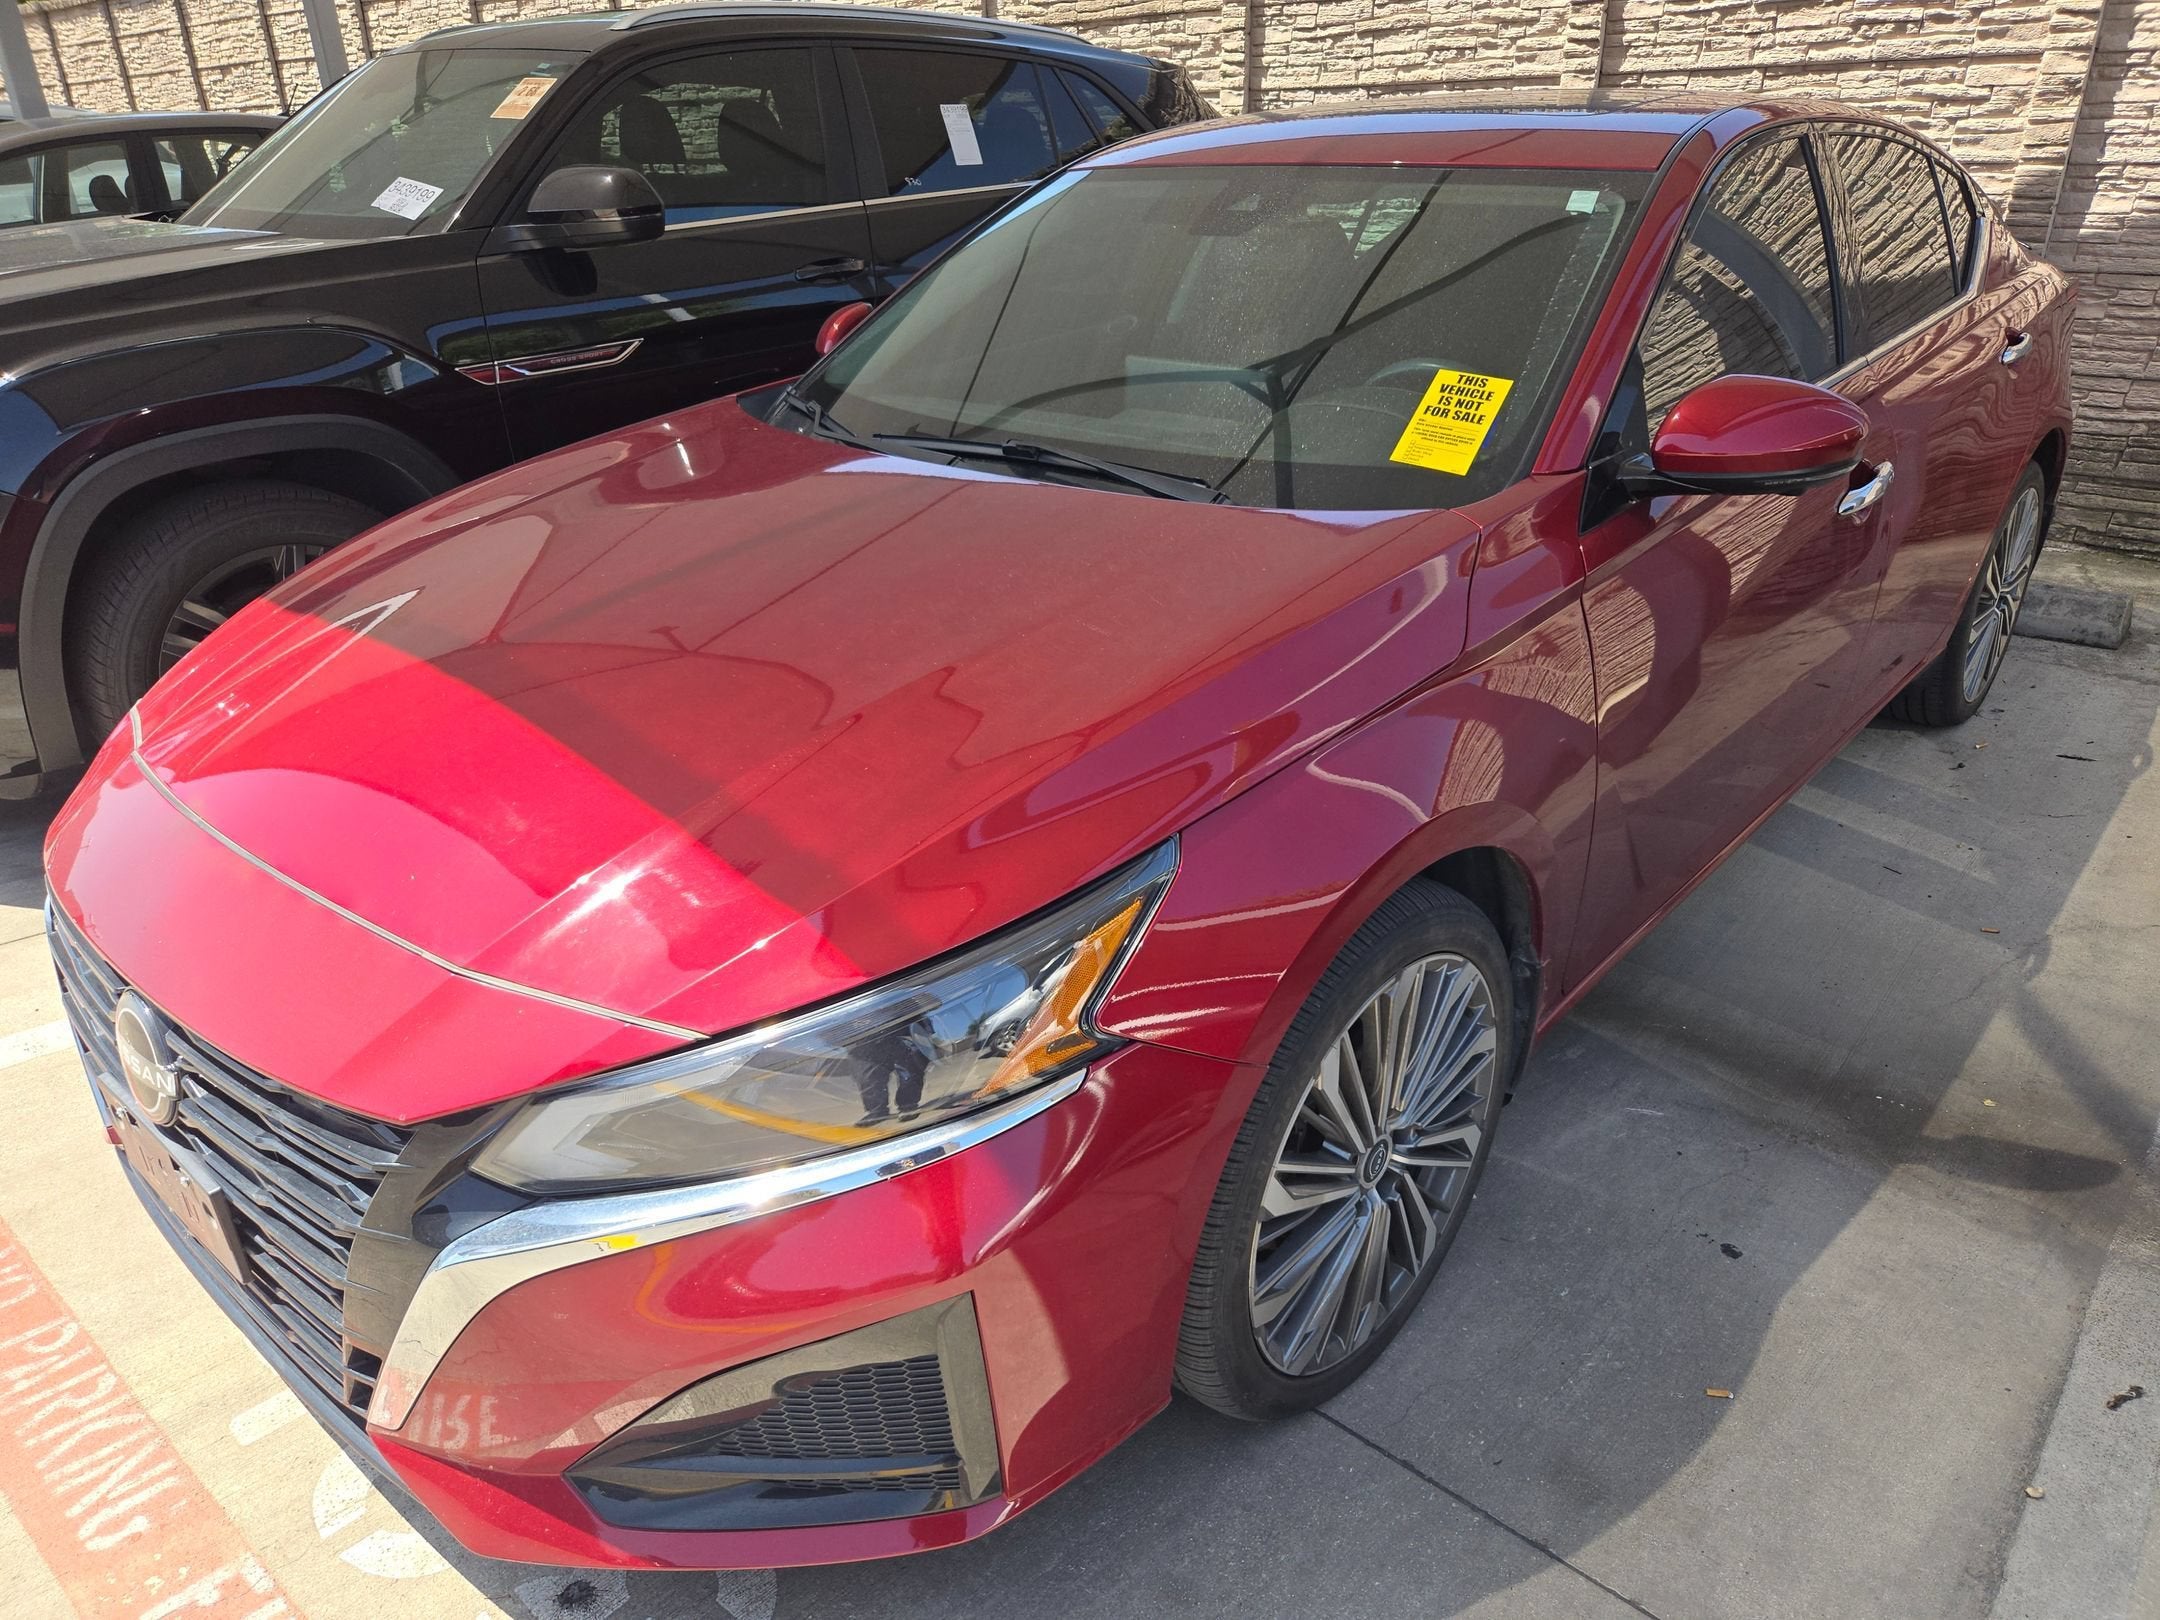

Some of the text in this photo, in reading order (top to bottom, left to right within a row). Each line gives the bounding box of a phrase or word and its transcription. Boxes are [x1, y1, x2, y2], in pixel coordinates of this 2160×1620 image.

[550, 351, 604, 364] CROSS SPORT
[1456, 374, 1489, 388] THIS
[1439, 384, 1495, 402] VEHICLE
[1437, 395, 1484, 412] IS NOT
[1423, 405, 1486, 426] FOR SALE
[0, 1314, 187, 1551] PARKING
